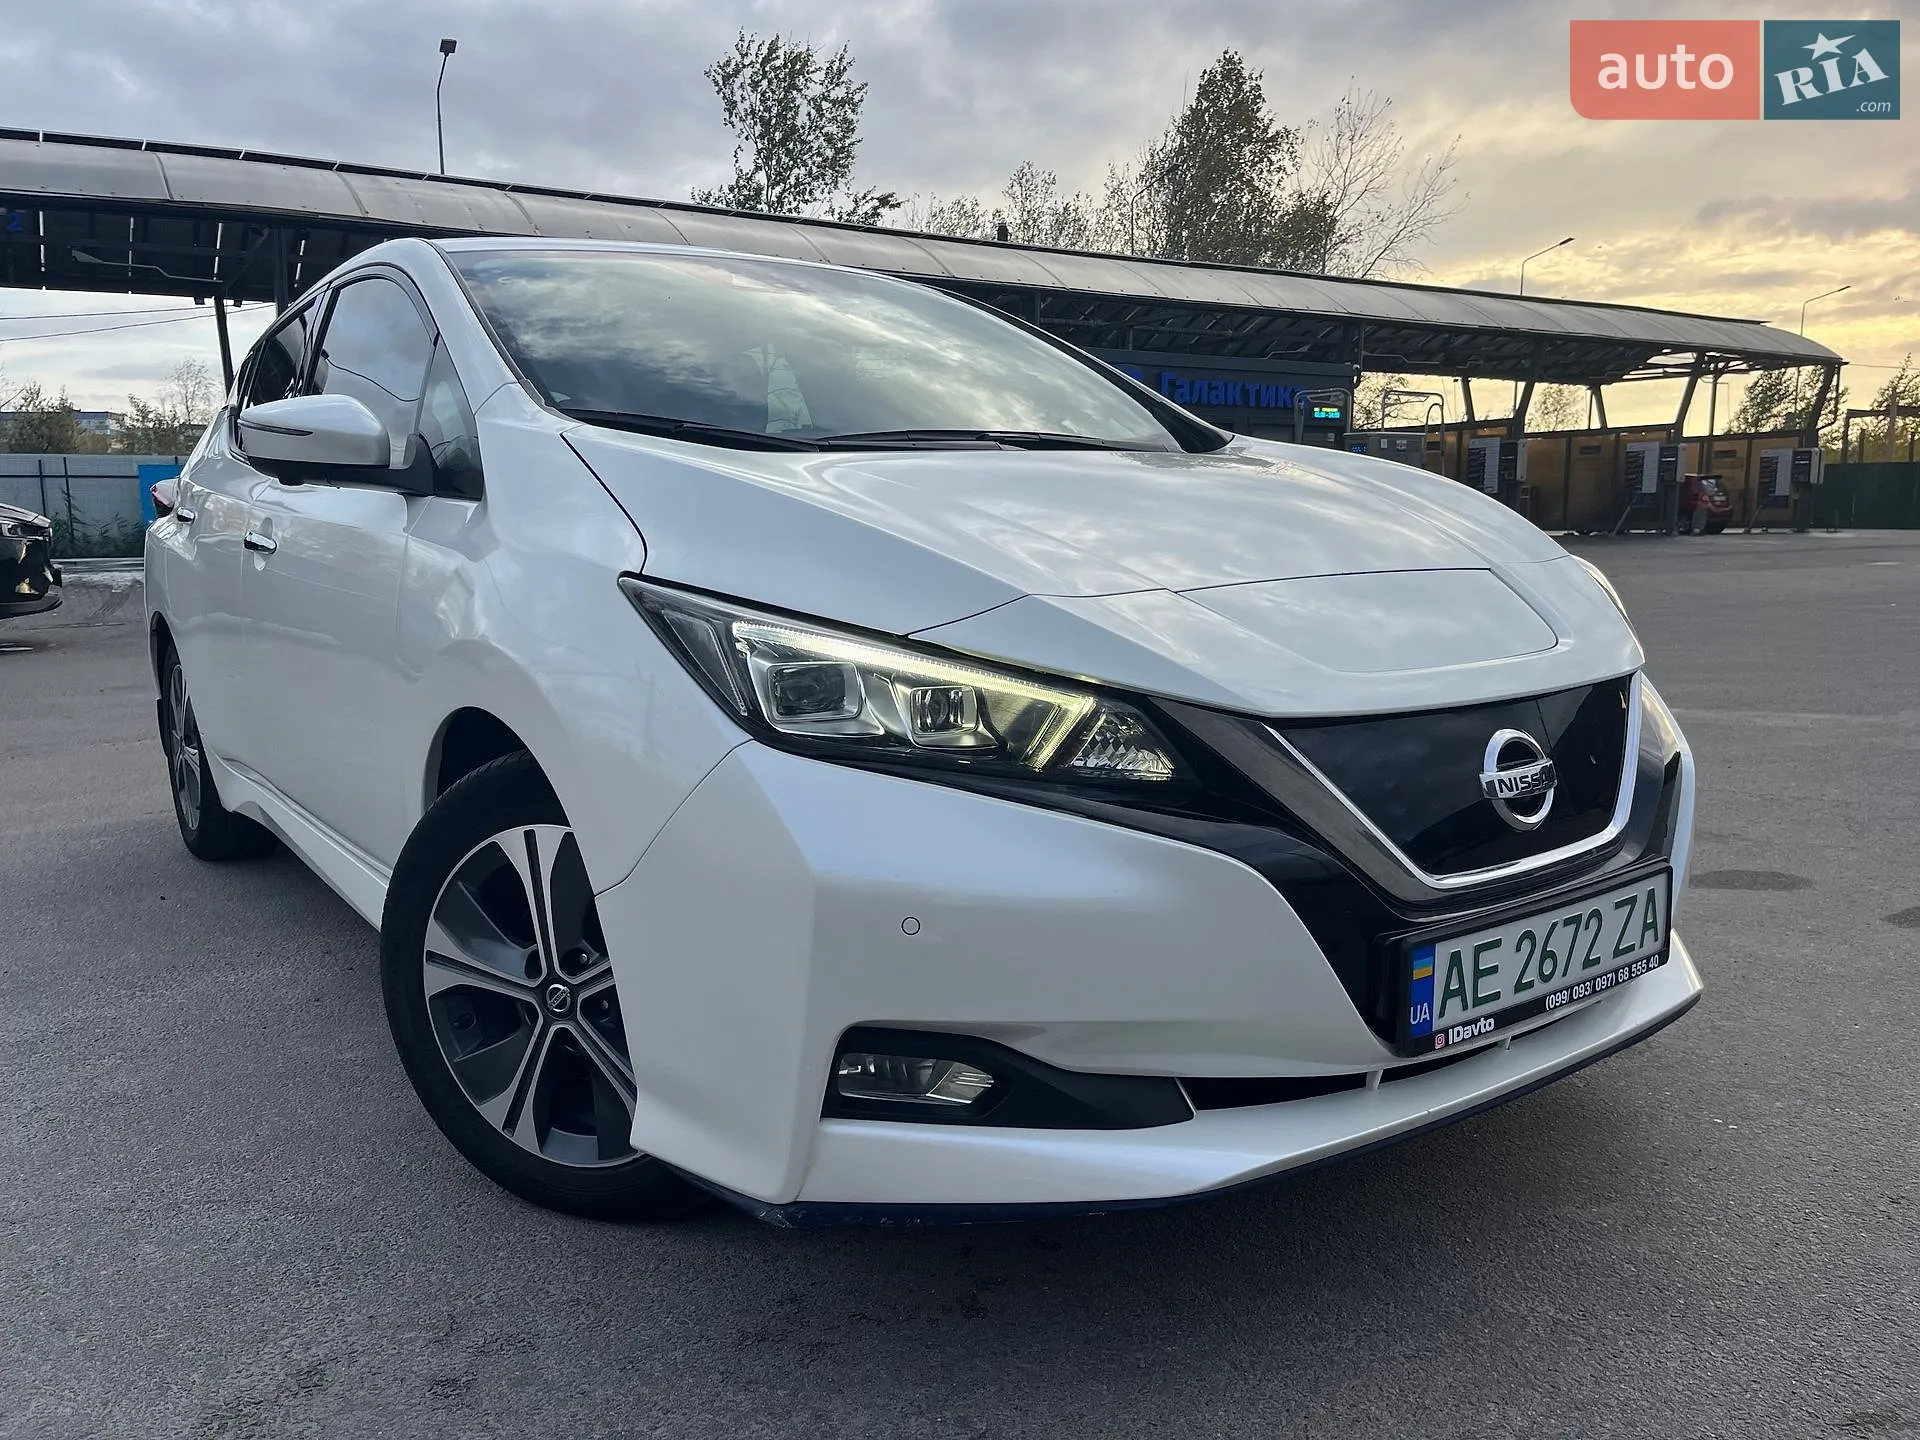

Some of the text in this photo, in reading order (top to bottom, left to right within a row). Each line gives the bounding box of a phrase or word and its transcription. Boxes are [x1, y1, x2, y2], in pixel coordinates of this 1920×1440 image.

[1438, 886, 1660, 1019] AE 2672 ZA
[1618, 966, 1630, 983] 68
[1631, 960, 1647, 977] 555
[1649, 954, 1660, 969] 40
[1409, 1002, 1430, 1025] UA
[1448, 1017, 1495, 1045] IDavto
